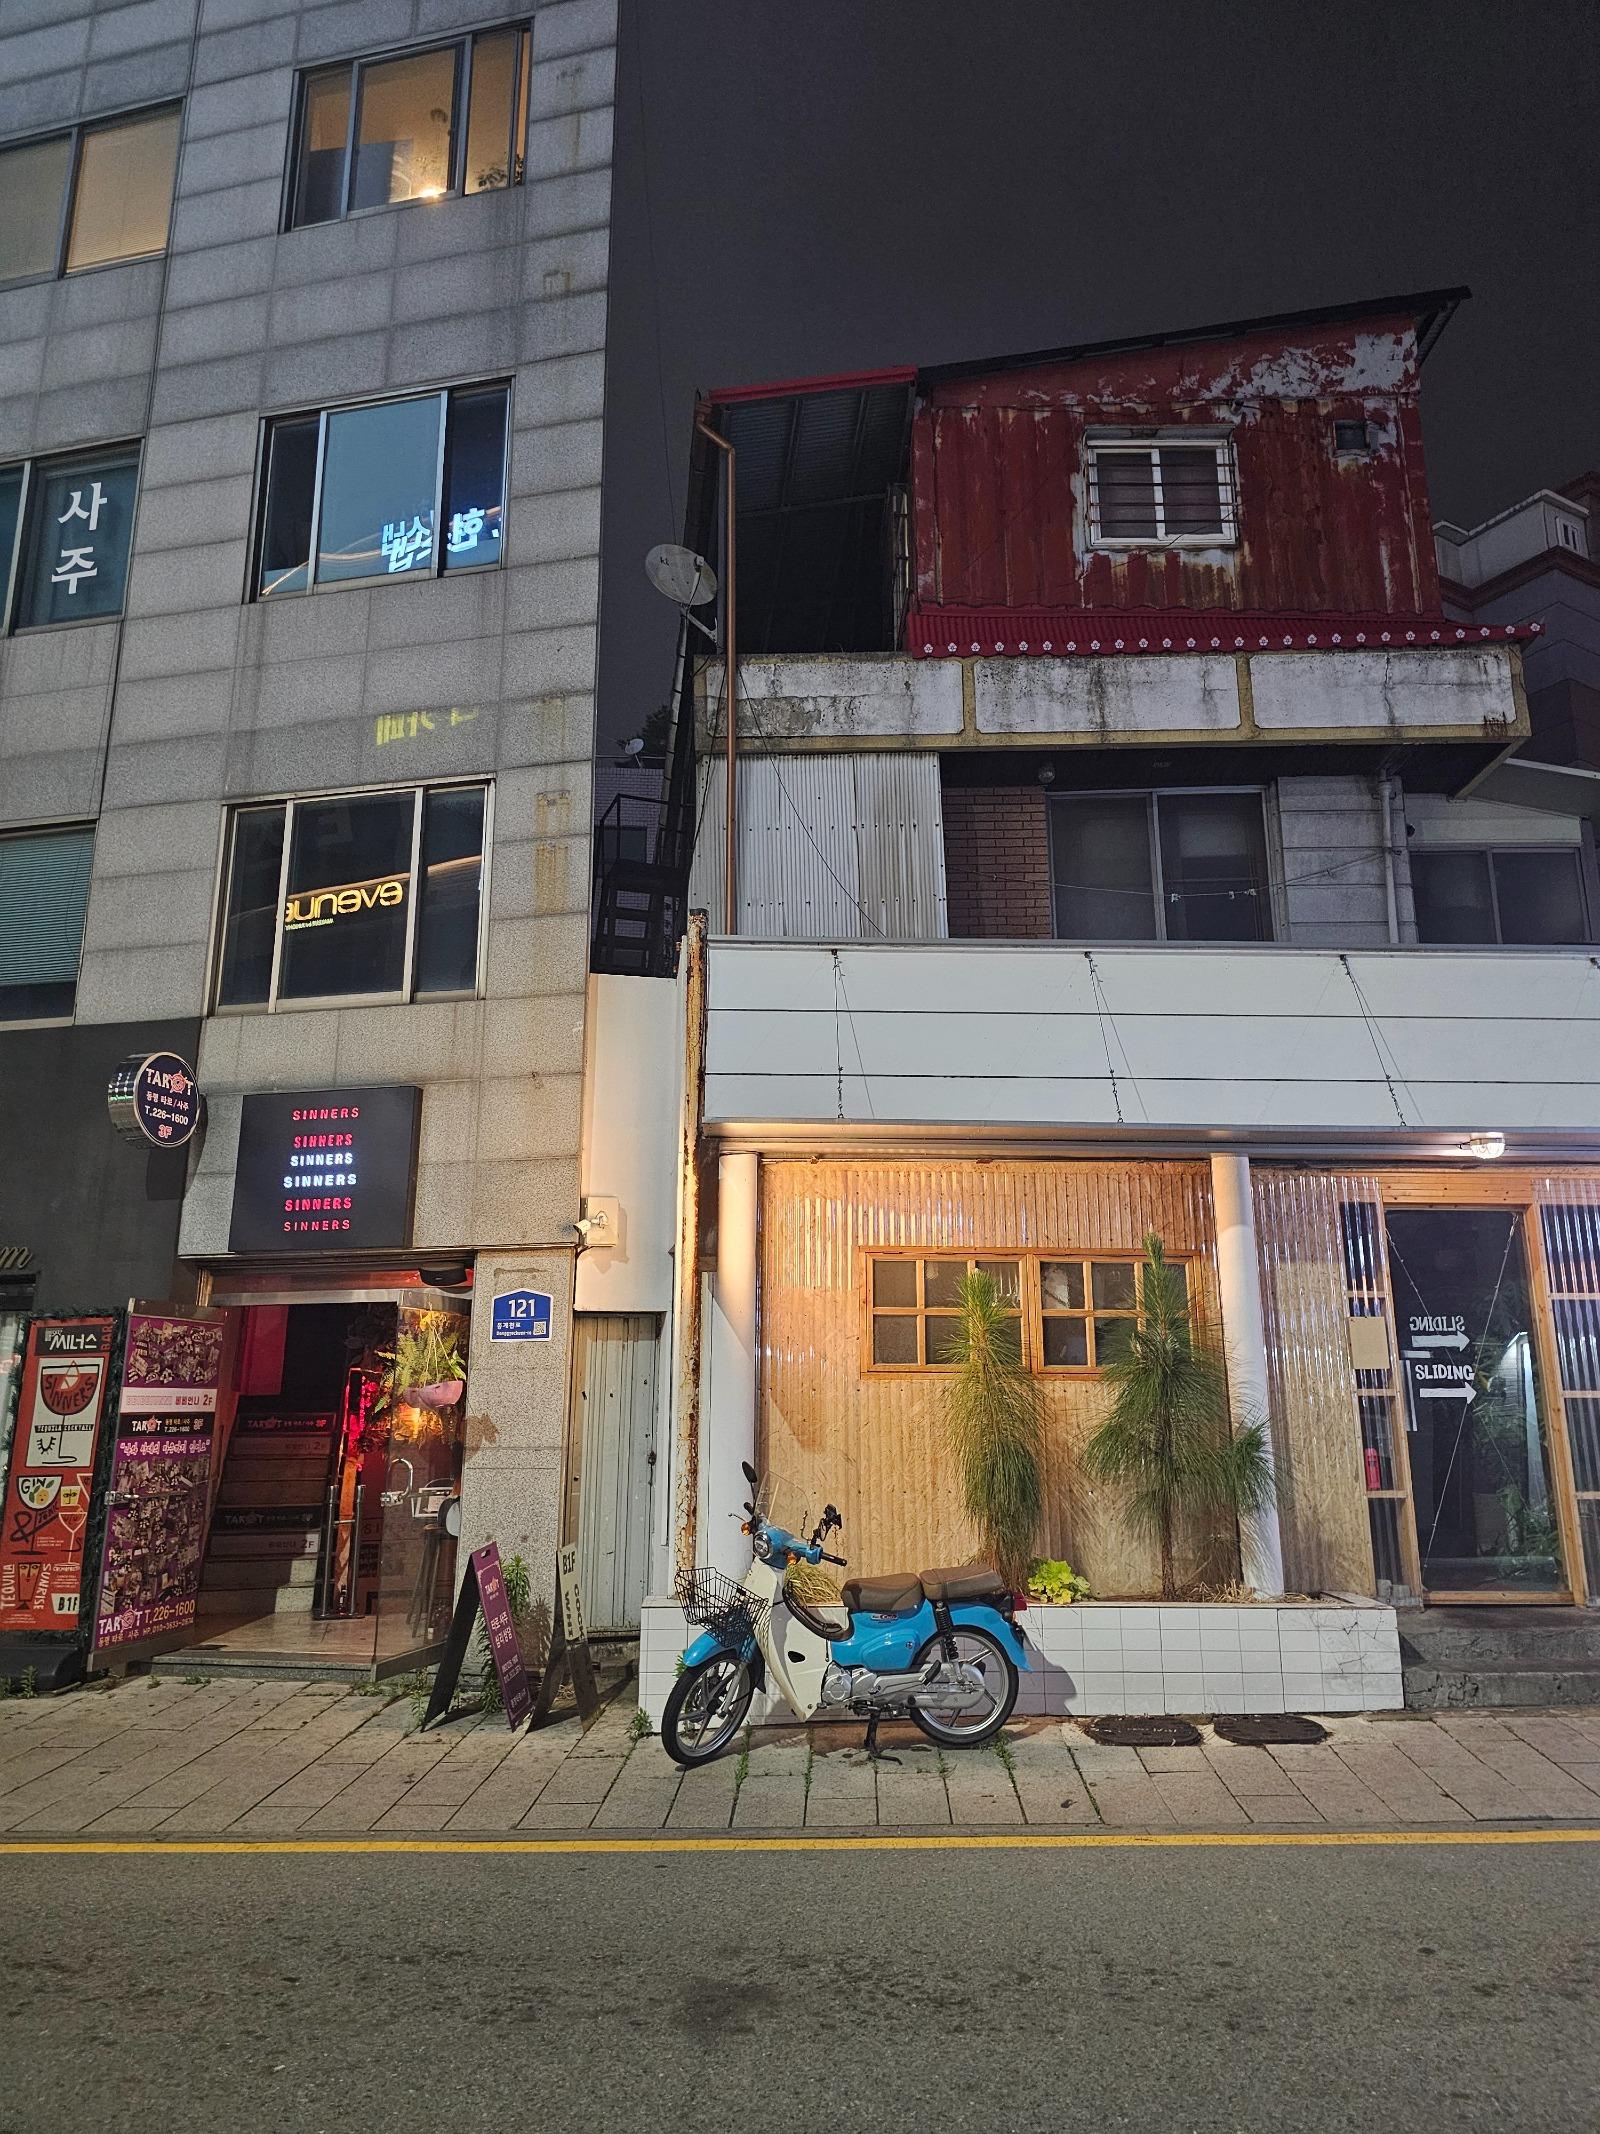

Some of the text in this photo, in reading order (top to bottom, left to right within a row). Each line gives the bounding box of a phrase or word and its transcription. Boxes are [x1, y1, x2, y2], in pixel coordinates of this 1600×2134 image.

[52, 482, 107, 594] 사주
[146, 1067, 193, 1095] TAROT
[292, 1107, 359, 1120] SINNERS
[158, 1124, 172, 1138] 3F
[293, 1133, 353, 1148] SINNERS
[290, 1152, 353, 1167] SINNERS
[283, 1173, 357, 1188] SINNERS
[284, 1197, 352, 1212] SINNERS
[283, 1219, 350, 1232] SINNERS
[508, 1299, 535, 1318] 121
[101, 1324, 113, 1351] BAR
[1415, 1364, 1475, 1380] SLIDING
[45, 1375, 95, 1411] SINNERS
[202, 1394, 213, 1406] 2F
[37, 1424, 62, 1432] TEQUILA
[131, 1417, 162, 1433] TAROT
[21, 1478, 46, 1494] GIN
[302, 1539, 315, 1549] 2F
[563, 1550, 576, 1575] B1F
[33, 1563, 51, 1610] SUNRISE
[58, 1597, 78, 1611] B1F
[144, 1599, 195, 1624] T.226-1600
[99, 1605, 143, 1634] TAROT
